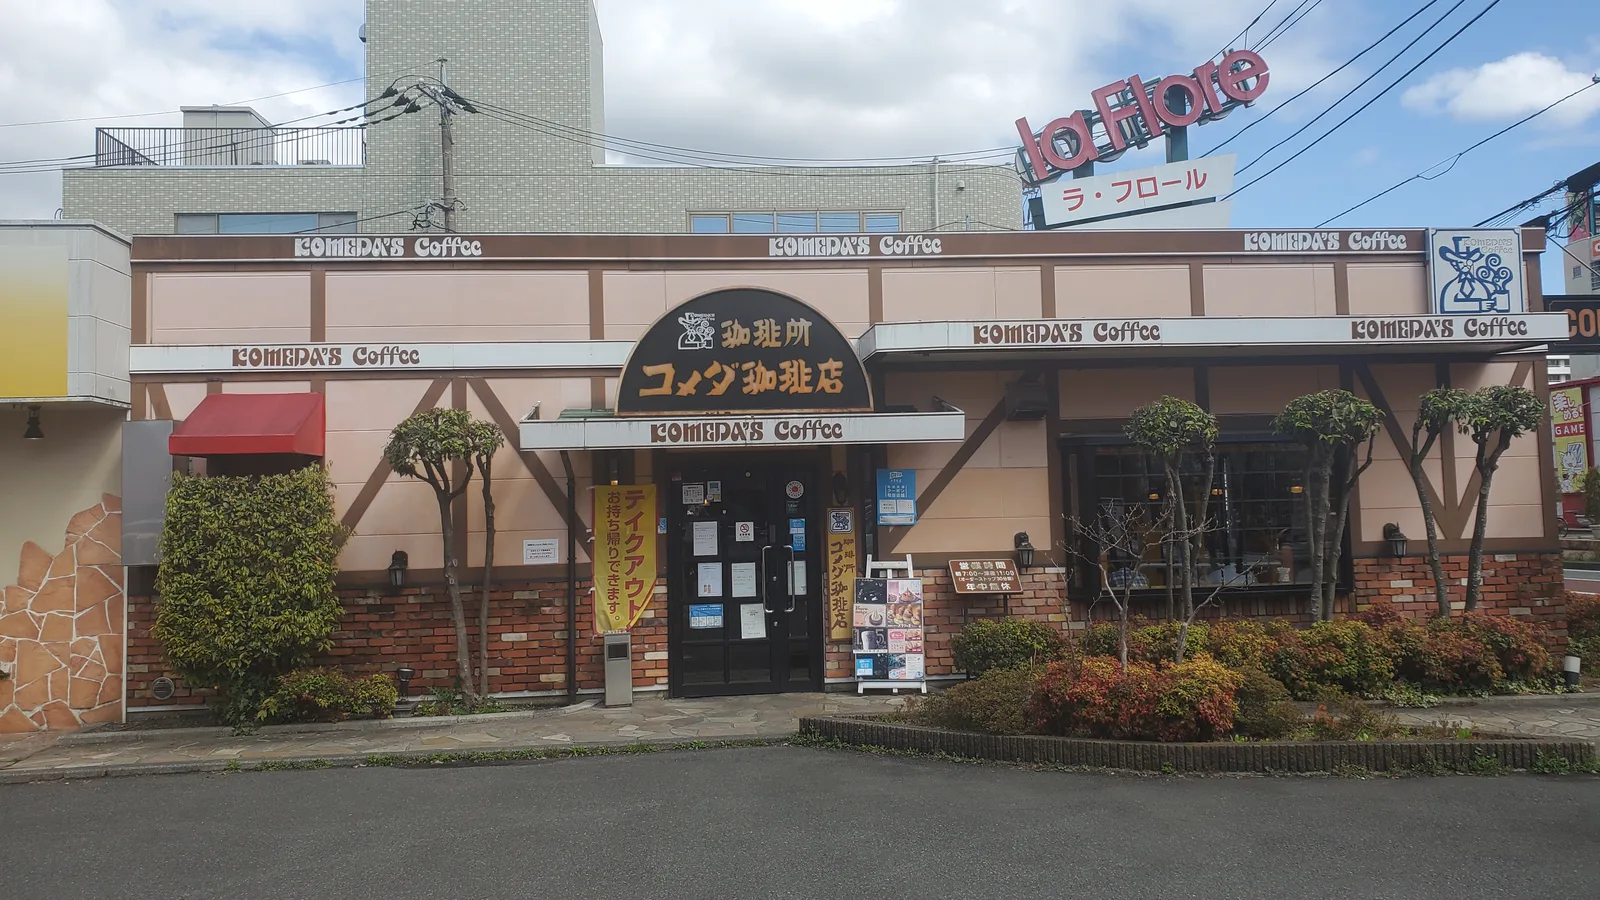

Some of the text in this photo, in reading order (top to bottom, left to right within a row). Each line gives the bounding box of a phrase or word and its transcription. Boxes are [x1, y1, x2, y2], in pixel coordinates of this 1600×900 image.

[1062, 168, 1207, 212] ラ・フロール
[294, 236, 482, 257] KOMEDA'S Coffee
[768, 234, 942, 256] KOMEDA'S Coffee
[1244, 231, 1407, 251] KOMEDA'S Coffee
[720, 317, 812, 349] 珈琲所
[973, 321, 1161, 344] KOMEDA'S Coffee
[1351, 317, 1528, 339] KOMEDA'S Coffee
[232, 345, 420, 368] KOMEDA'S Coffee
[639, 357, 844, 397] コメダ珈琲店
[650, 419, 843, 444] KOMEDA'S Coffee
[1555, 425, 1585, 436] GAME
[606, 491, 620, 621] お持ち帰りできます。
[624, 489, 645, 620] テイクアウト
[843, 538, 856, 574] 珈琲所
[830, 540, 849, 631] コメダ珈琲店
[966, 582, 1012, 591] 年中無休
